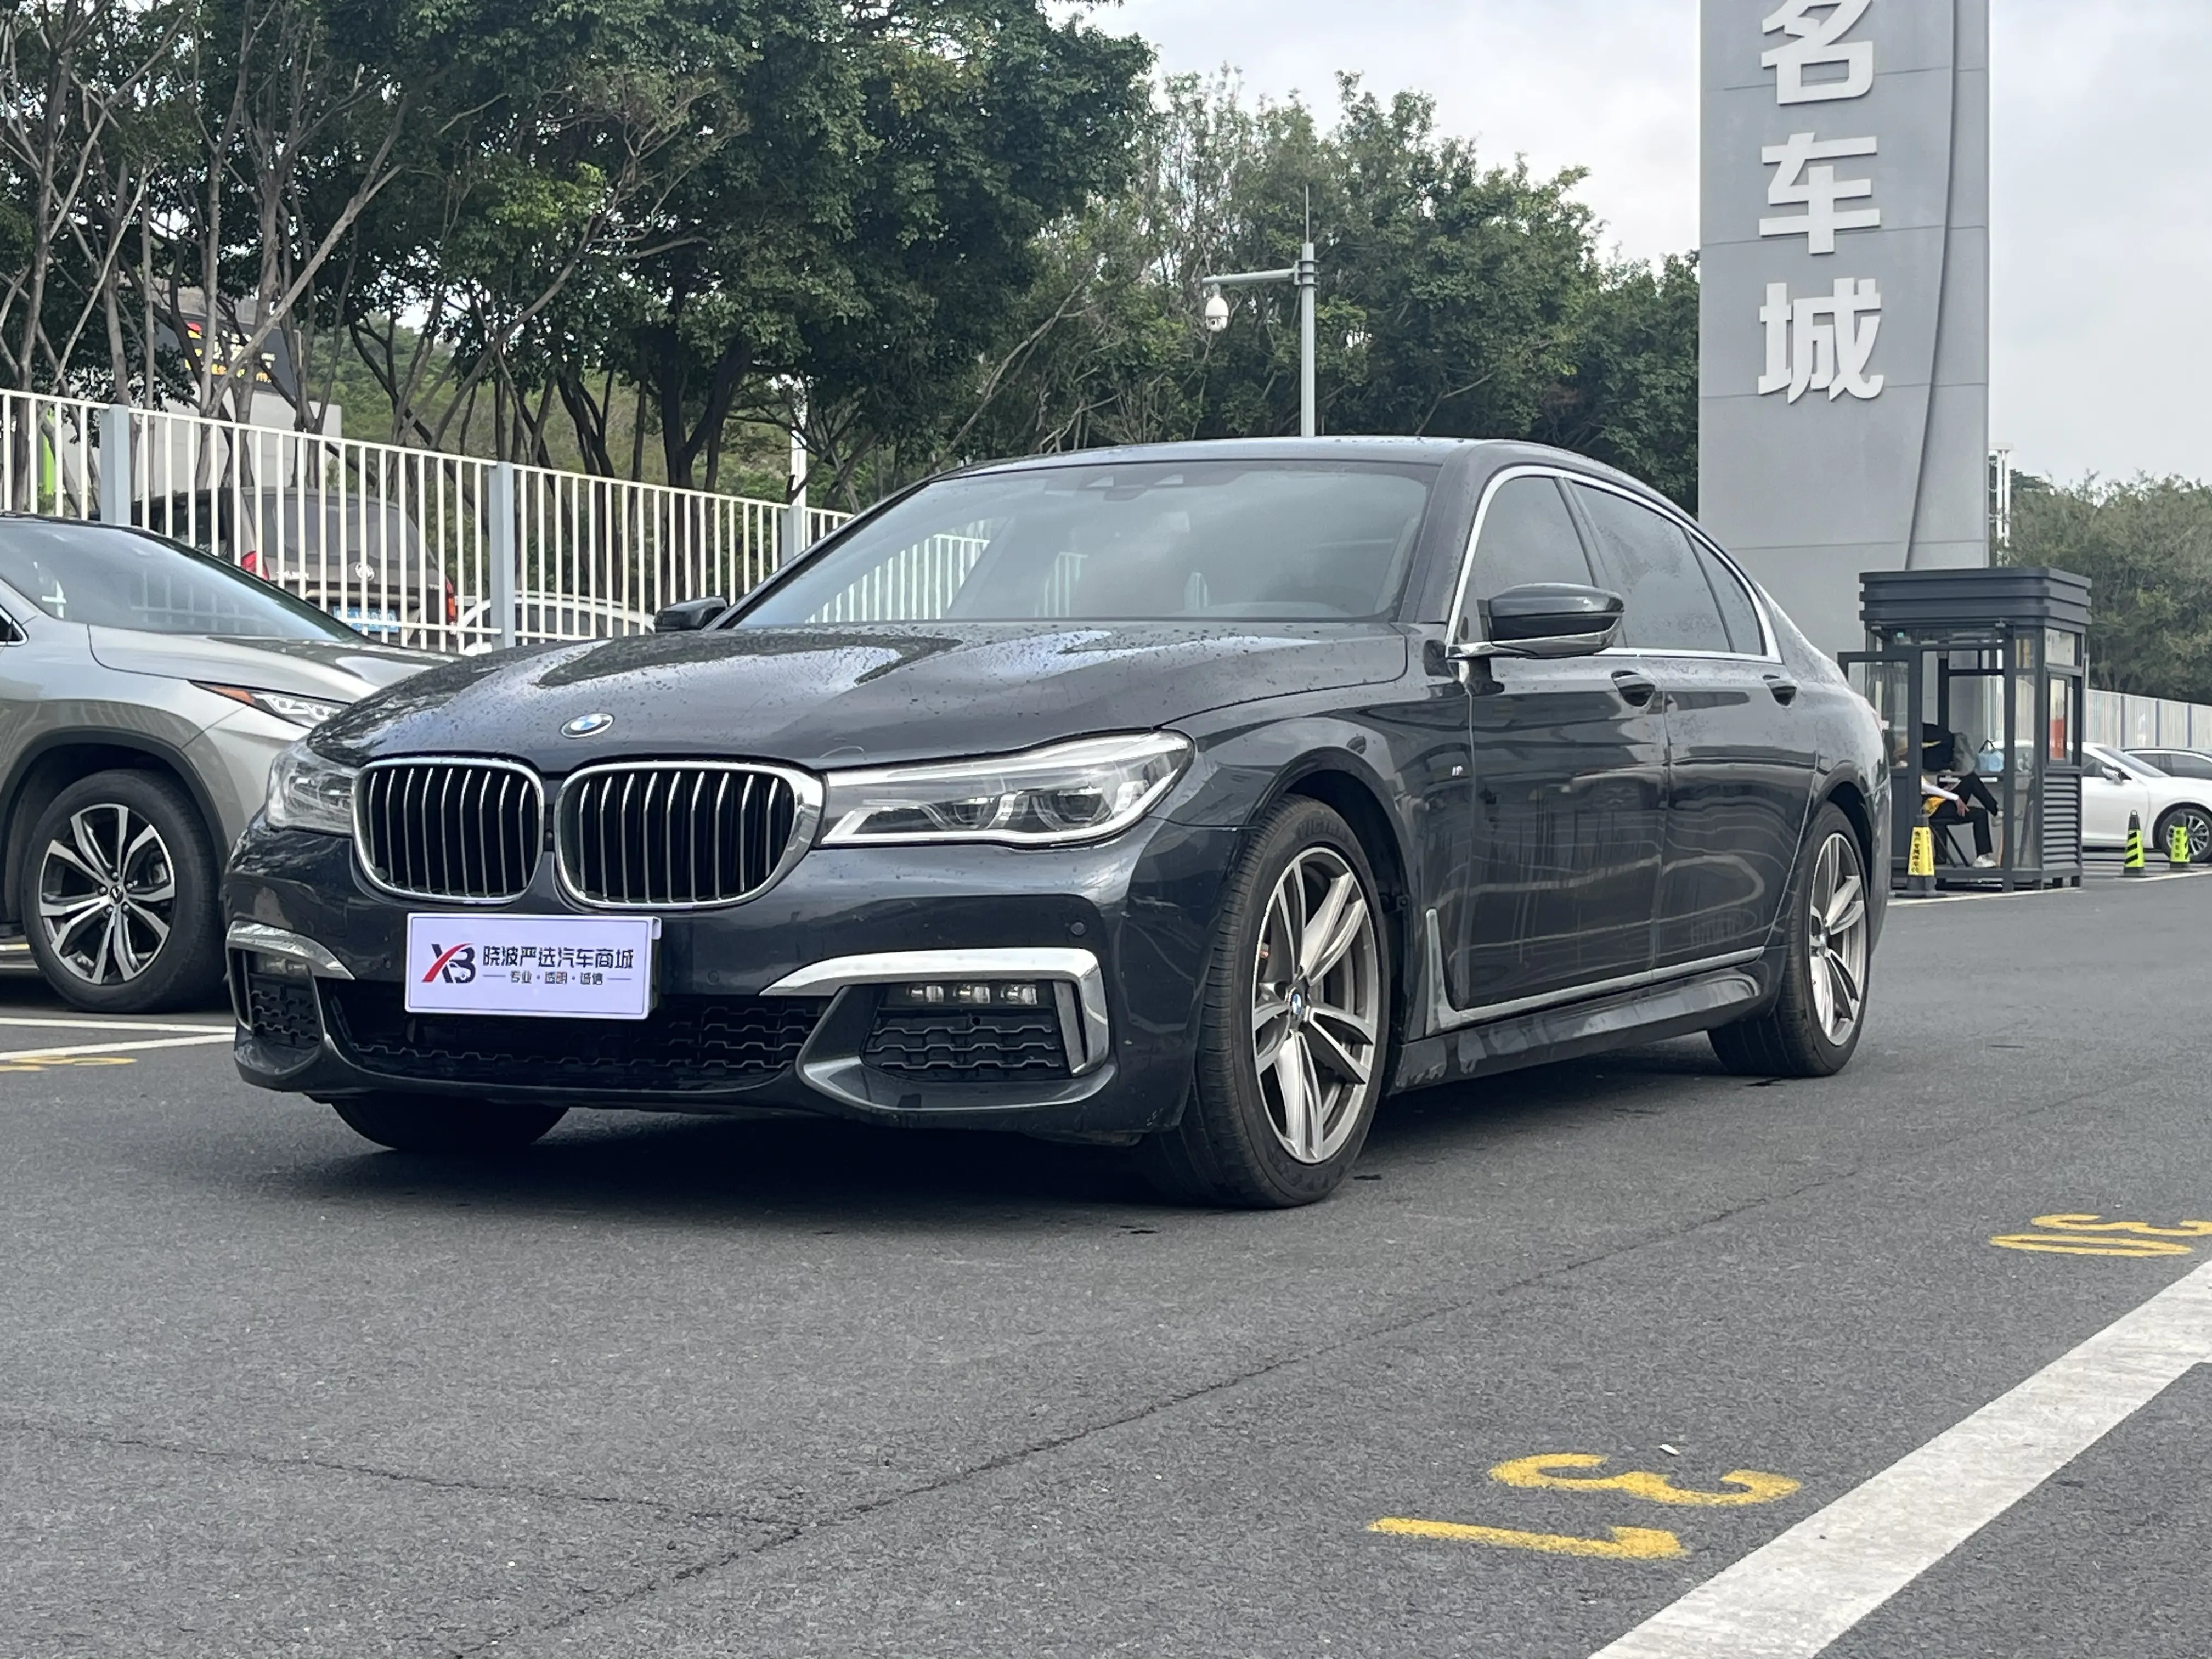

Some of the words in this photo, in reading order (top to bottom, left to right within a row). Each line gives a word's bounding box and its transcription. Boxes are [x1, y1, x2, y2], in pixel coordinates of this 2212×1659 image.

[1758, 0, 1884, 405] 名车城
[483, 945, 634, 969] 晓波严选汽车商城
[1367, 1453, 1802, 1560] 31
